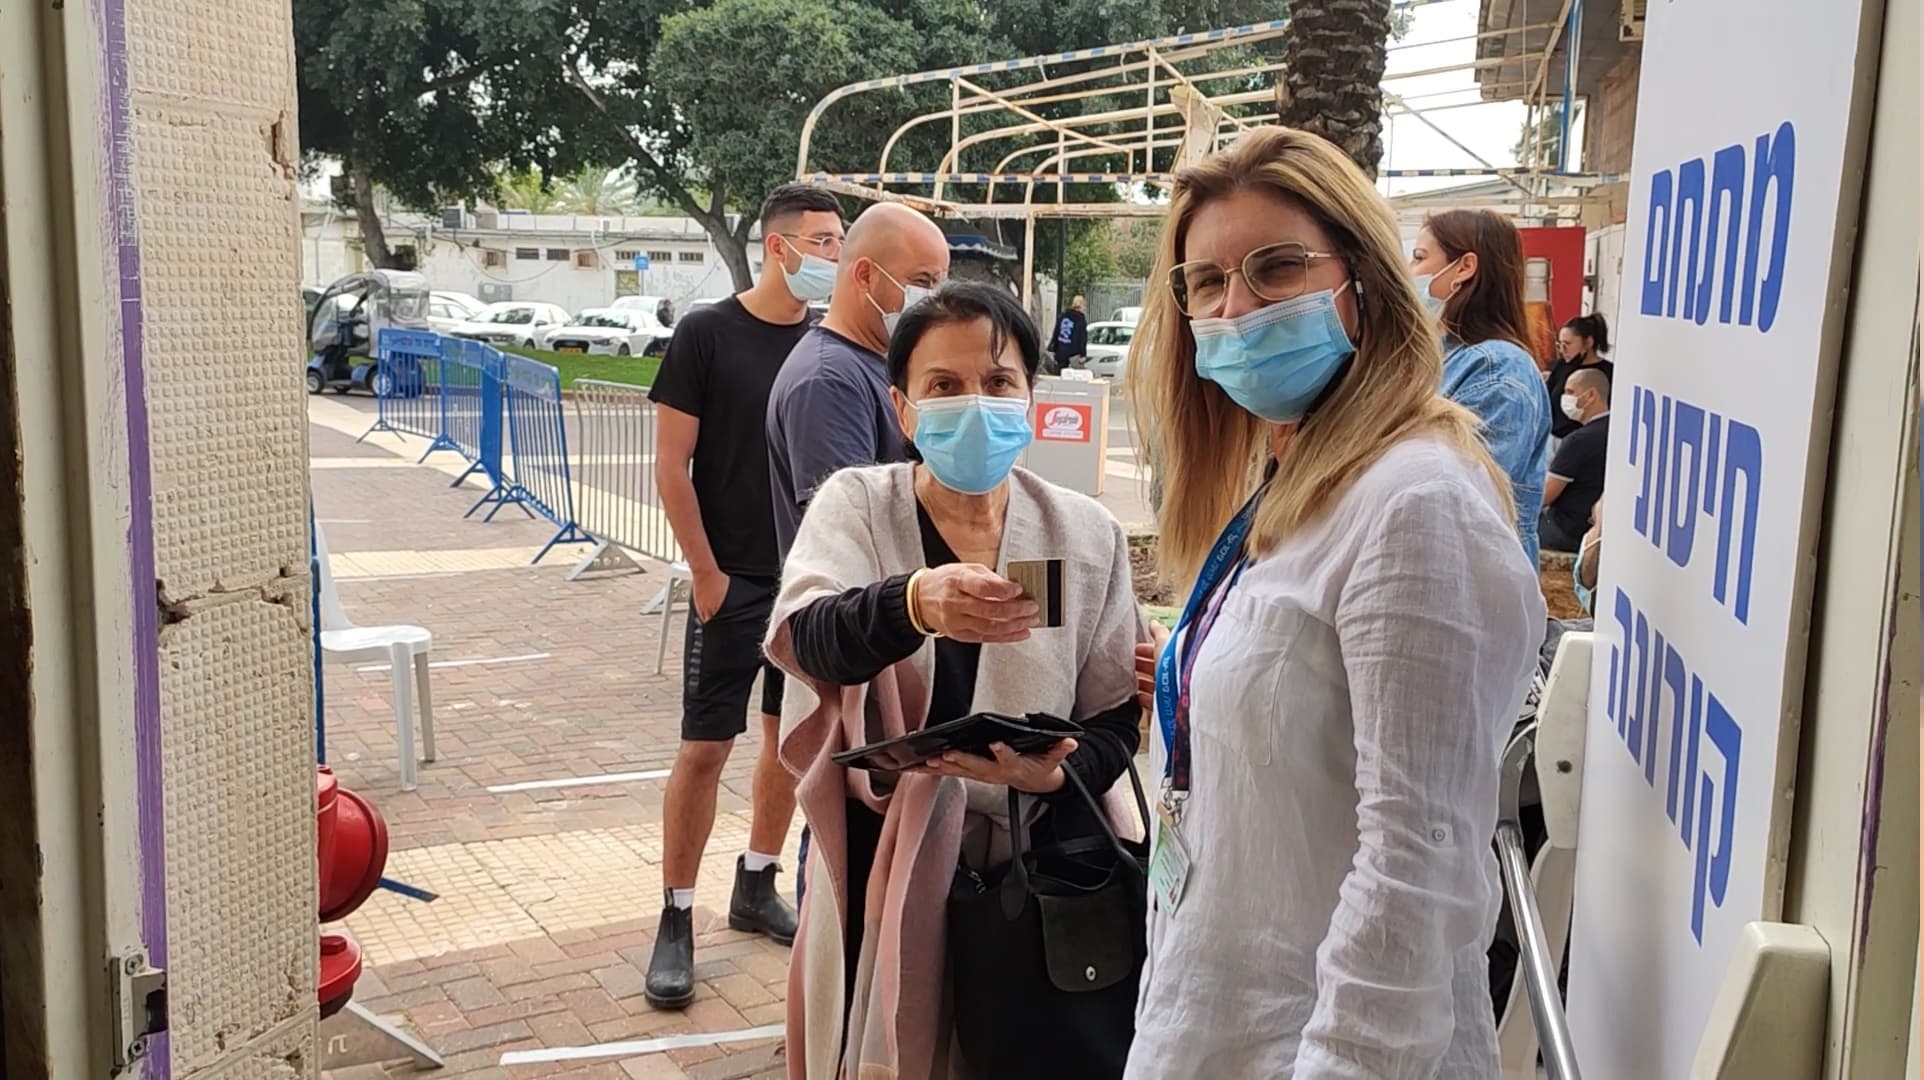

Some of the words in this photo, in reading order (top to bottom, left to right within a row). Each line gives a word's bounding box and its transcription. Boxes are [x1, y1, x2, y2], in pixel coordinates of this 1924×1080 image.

[1640, 121, 1796, 333] מתחם
[1628, 386, 1763, 626] חיסוני
[1607, 585, 1742, 947] קורונה
